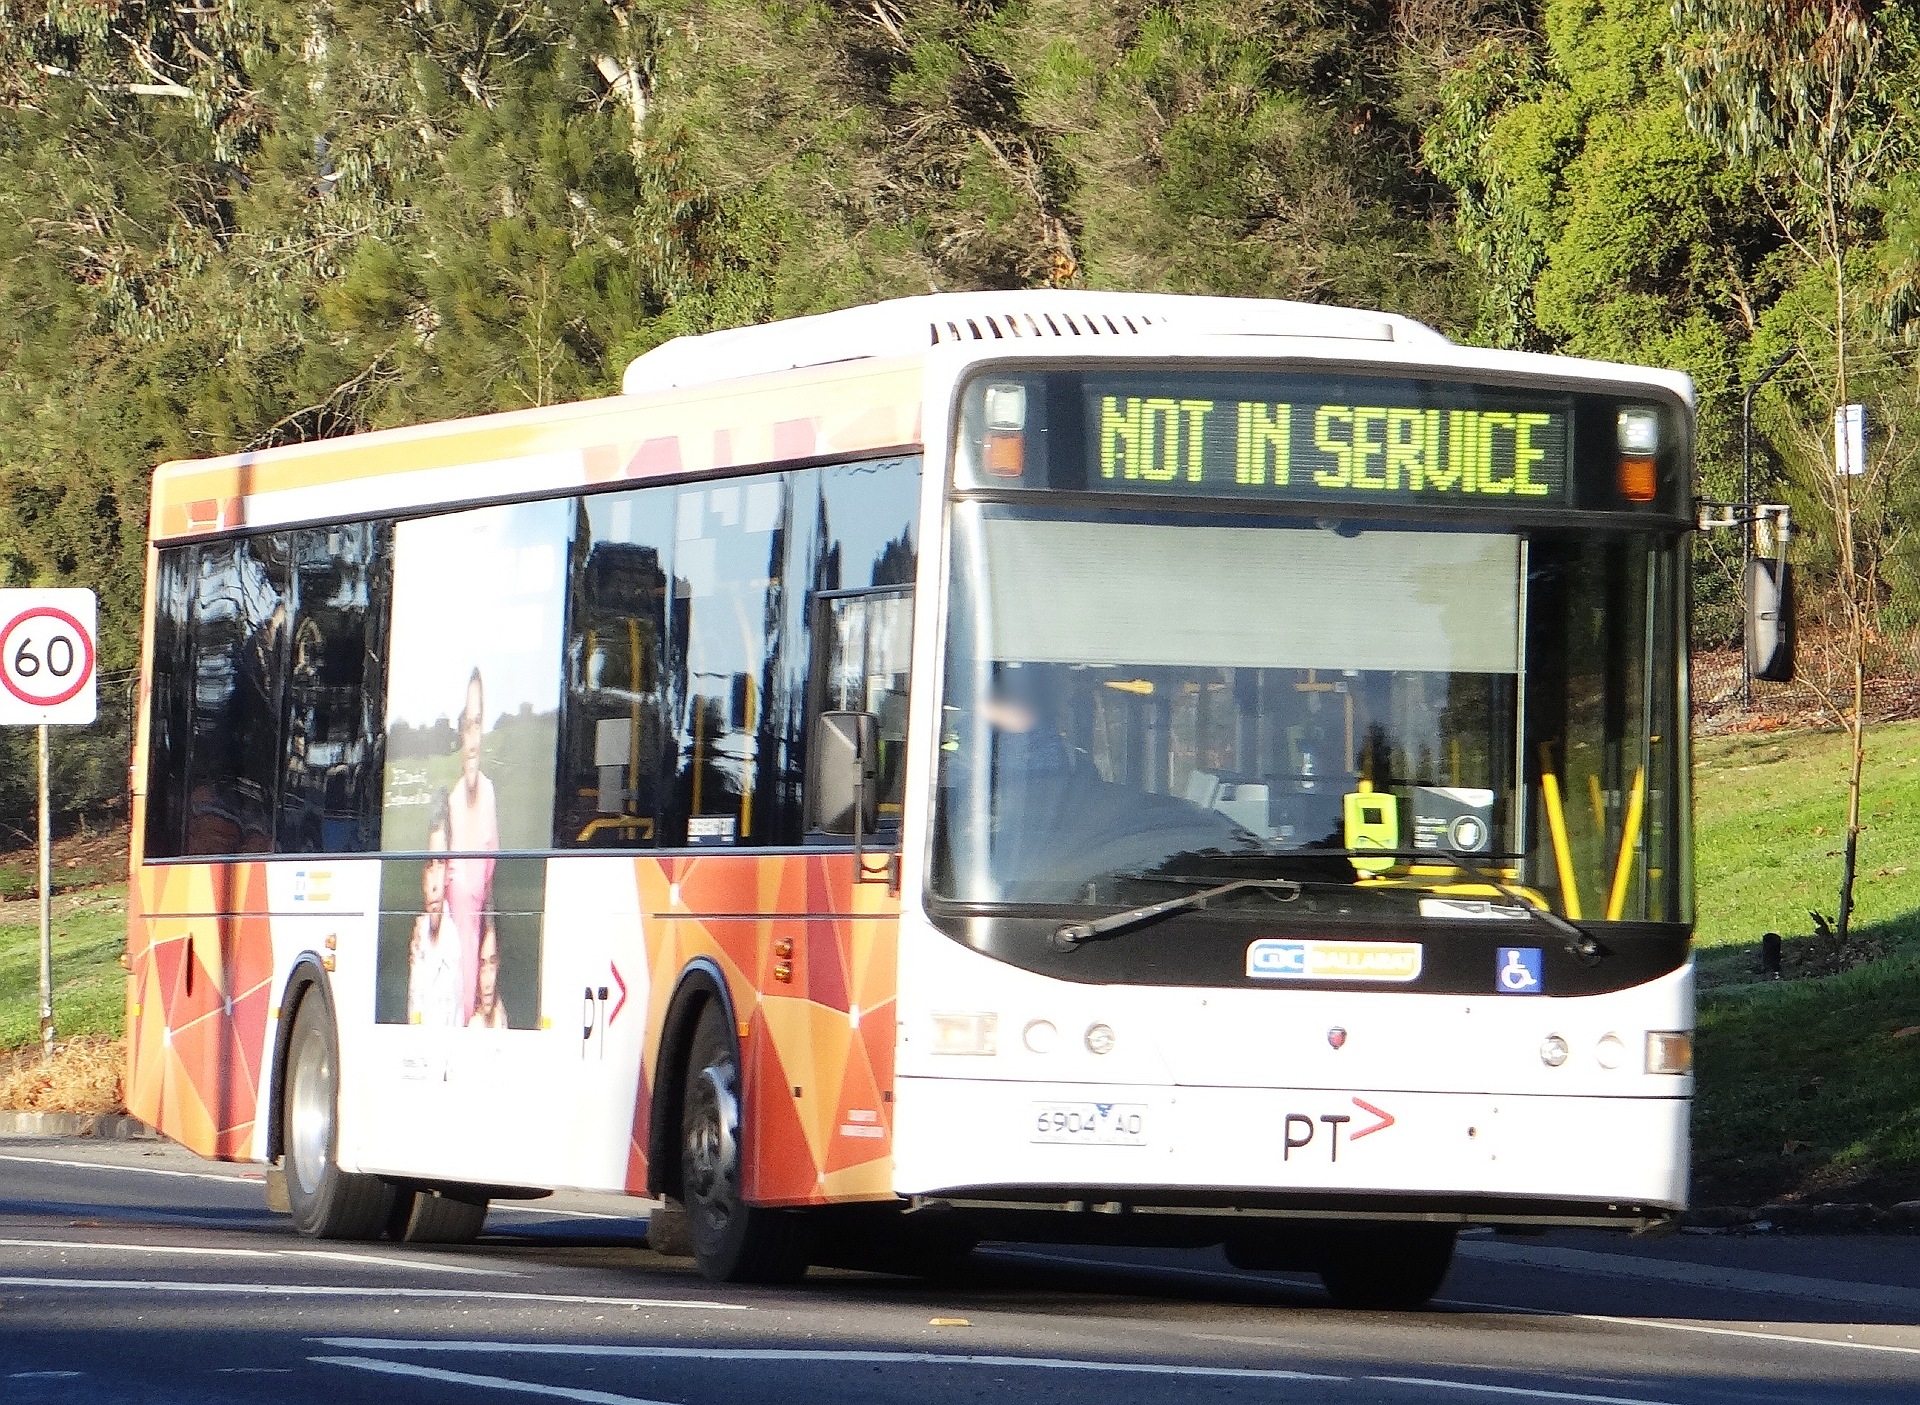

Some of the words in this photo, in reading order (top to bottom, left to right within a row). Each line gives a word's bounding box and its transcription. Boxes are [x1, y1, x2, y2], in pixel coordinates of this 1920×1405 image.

[1100, 396, 1214, 483] NOT
[1235, 402, 1292, 486] IN
[1313, 405, 1551, 496] SERVICE
[14, 635, 74, 677] 60
